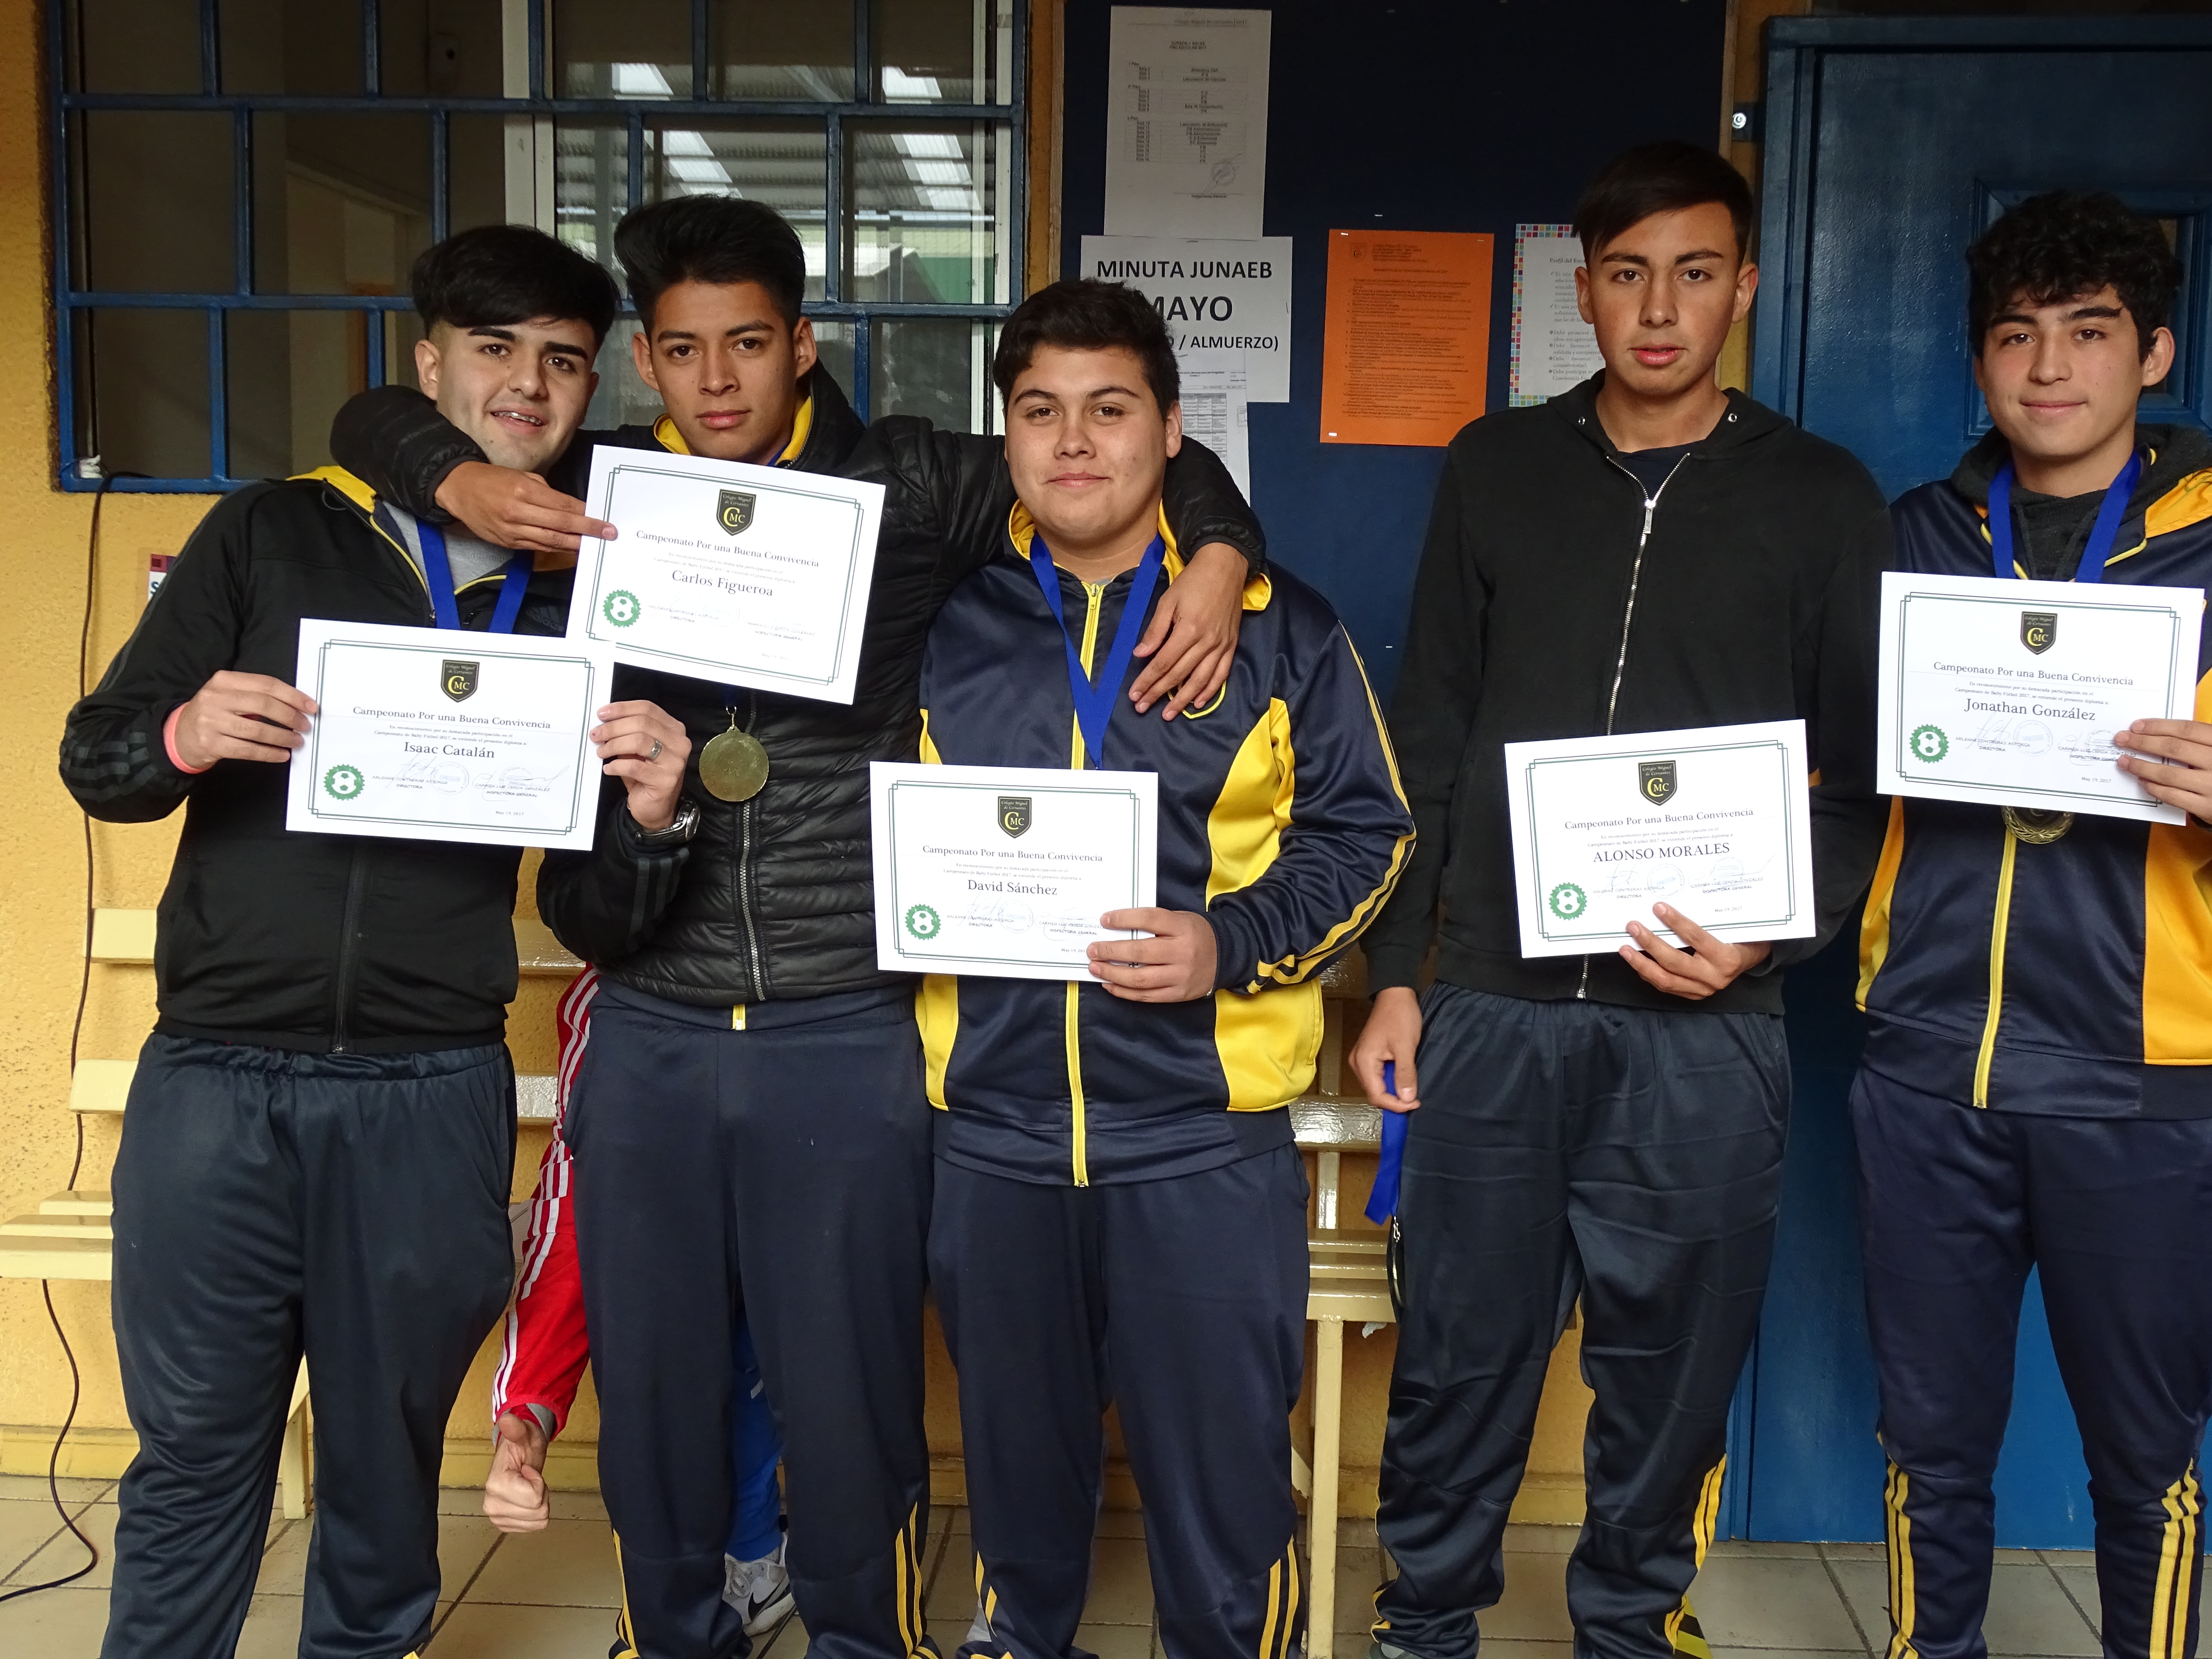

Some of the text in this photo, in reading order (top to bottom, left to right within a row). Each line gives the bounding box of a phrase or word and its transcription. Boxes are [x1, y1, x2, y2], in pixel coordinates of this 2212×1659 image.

[1097, 260, 1272, 279] MINUTA JUNAEB
[1179, 335, 1186, 350] /
[1190, 336, 1278, 352] ALMUERZO)
[636, 530, 693, 546] Campeonato
[697, 540, 712, 549] Por
[734, 546, 761, 558] Buena
[764, 552, 818, 567] Convivencia
[672, 570, 772, 596] Carlos Figueroa
[1934, 662, 1994, 674] Campeonato
[1997, 667, 2014, 676] Por
[2038, 670, 2068, 680] Buena
[2072, 673, 2133, 685] Convivencia
[353, 707, 416, 718] Campeonato
[419, 712, 435, 720] Por
[460, 715, 489, 724] Buena
[492, 717, 550, 728] Convivencia
[1964, 698, 2095, 721] Jonathan González
[404, 742, 494, 758] Isaac Catalán
[1565, 820, 1623, 830] Campeonato
[1697, 809, 1753, 820] Convivencia
[923, 845, 978, 856] Campeonato
[1018, 850, 1045, 859] Buena
[1048, 852, 1103, 862] Convivencia
[1594, 842, 1730, 862] ALONSO MORALES
[968, 879, 1057, 895] David Sánchez
